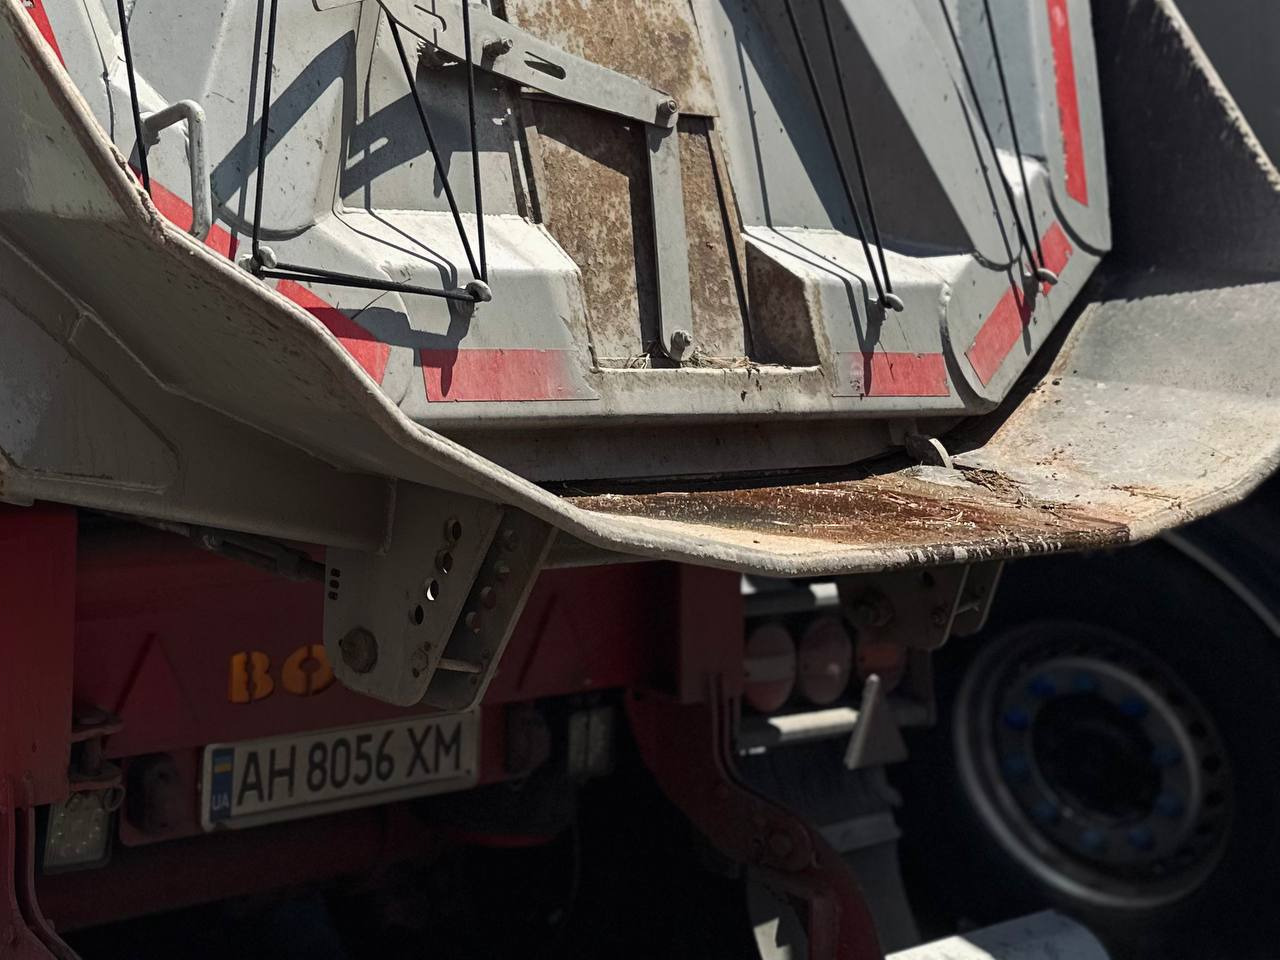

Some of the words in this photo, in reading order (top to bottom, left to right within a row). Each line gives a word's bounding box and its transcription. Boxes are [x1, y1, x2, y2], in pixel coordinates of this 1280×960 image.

[236, 744, 297, 807] AH
[306, 730, 395, 792] 8056
[405, 721, 463, 778] XM
[211, 794, 231, 811] UA
